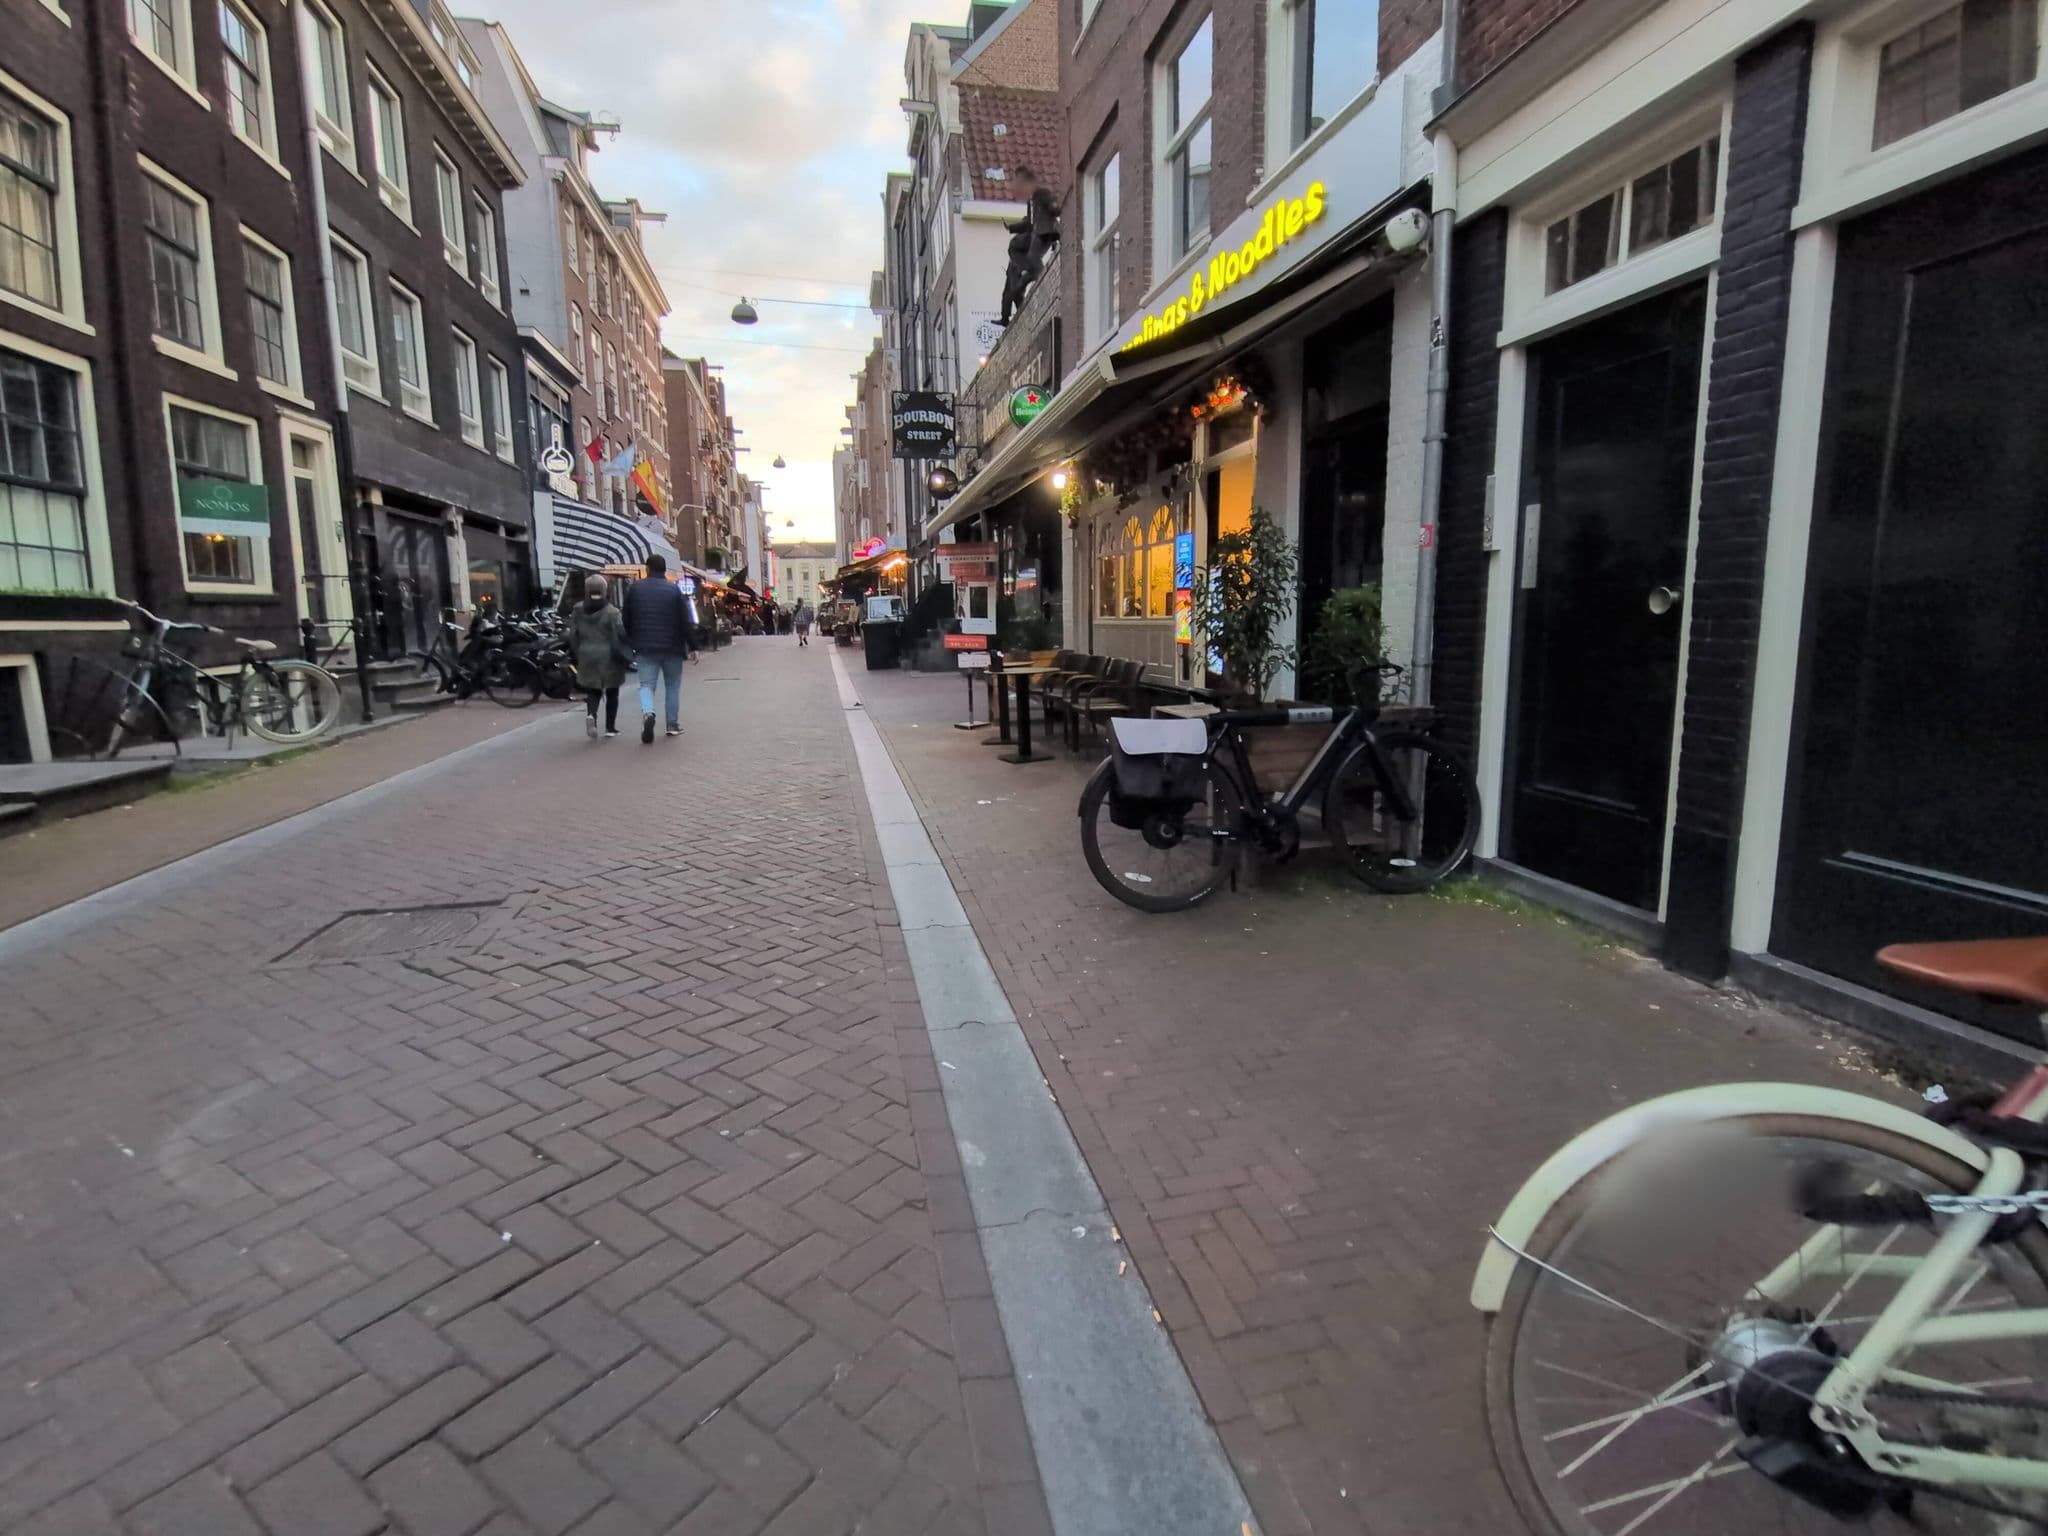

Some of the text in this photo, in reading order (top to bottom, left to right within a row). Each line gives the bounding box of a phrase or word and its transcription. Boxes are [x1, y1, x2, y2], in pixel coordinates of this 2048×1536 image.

[1190, 271, 1206, 313] &
[1209, 180, 1326, 300] Noodles
[894, 410, 954, 431] BOURBON
[906, 430, 942, 441] STREET
[194, 498, 250, 513] NOMOS
